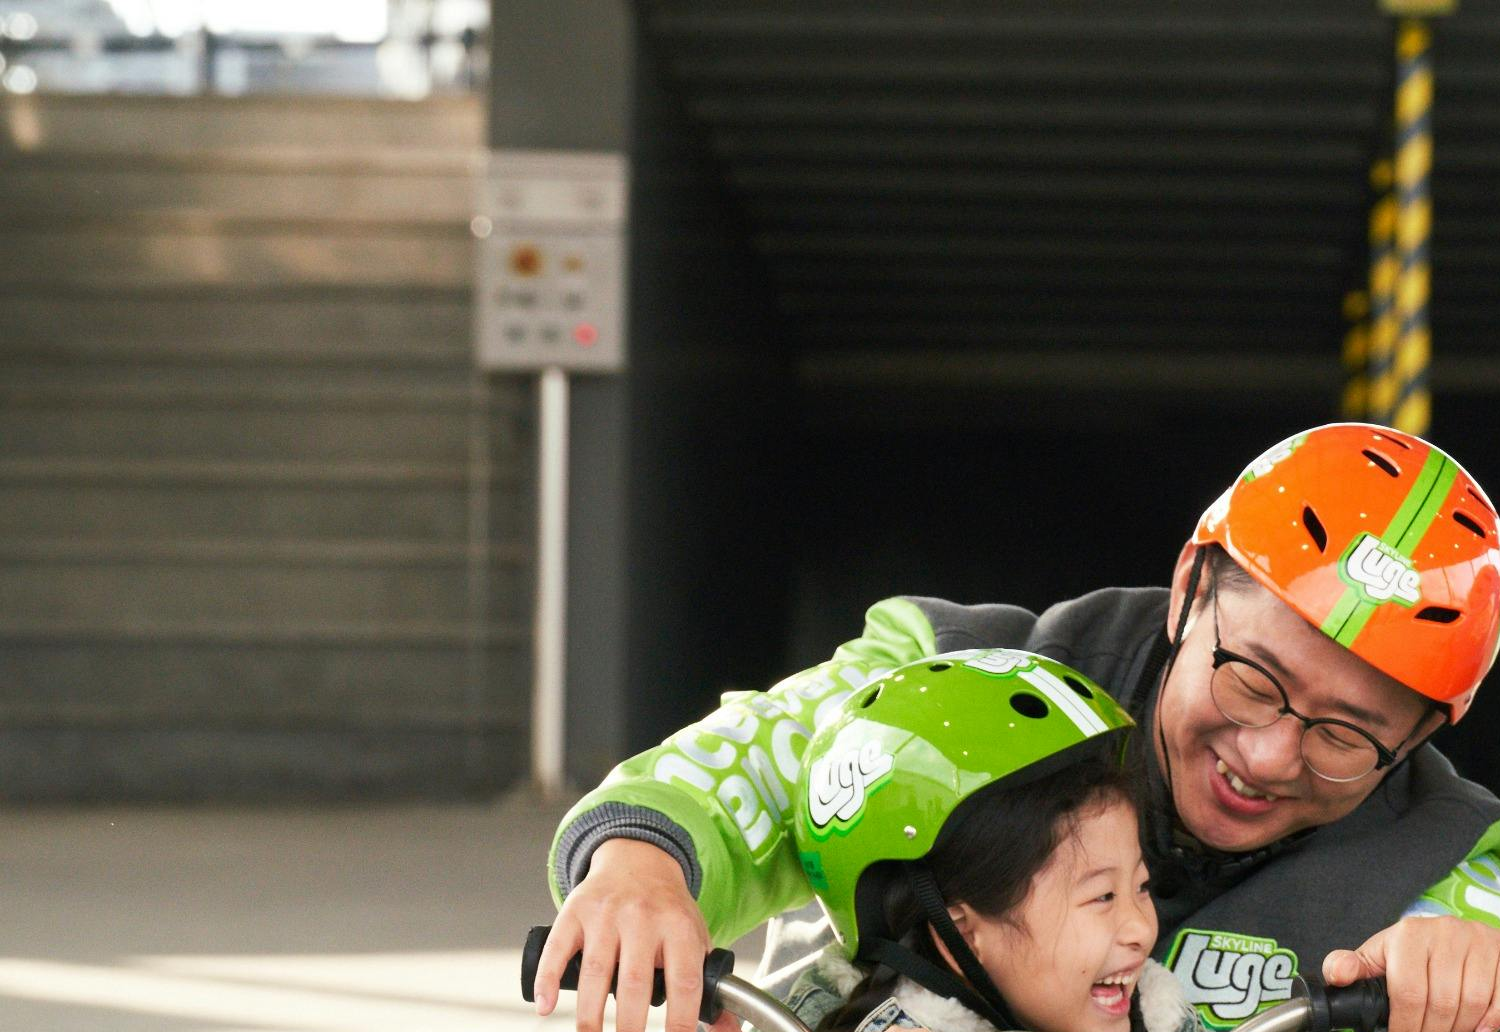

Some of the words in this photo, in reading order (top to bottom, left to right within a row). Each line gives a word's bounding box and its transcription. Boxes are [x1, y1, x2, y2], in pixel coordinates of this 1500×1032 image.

[1346, 533, 1421, 602] Luge
[808, 740, 895, 826] Luge
[1171, 933, 1294, 1019] Luge
[1211, 935, 1274, 954] SKYLINE
